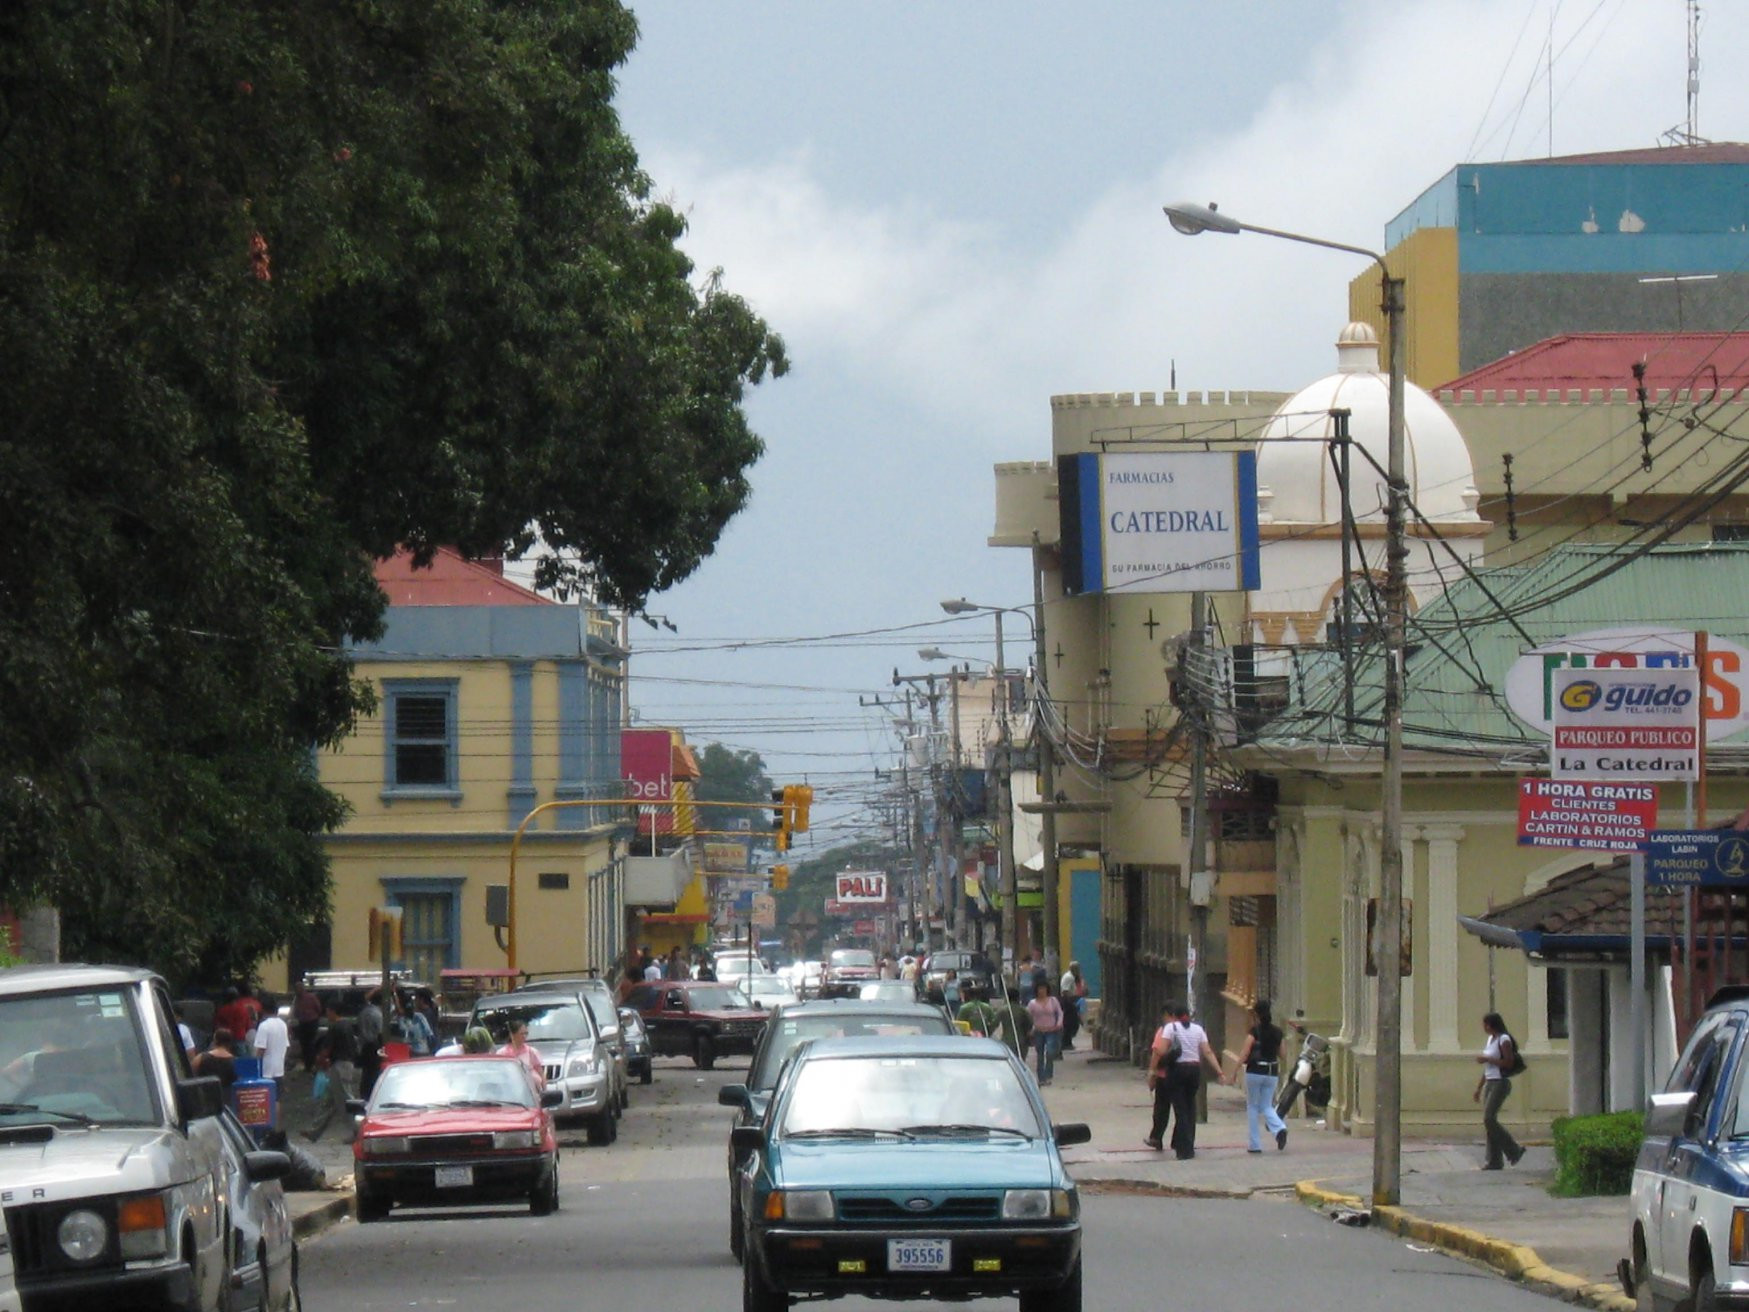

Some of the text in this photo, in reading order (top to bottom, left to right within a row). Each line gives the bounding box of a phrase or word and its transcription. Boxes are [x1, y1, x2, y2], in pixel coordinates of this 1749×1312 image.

[1109, 472, 1174, 484] FARMACIAS
[1111, 511, 1229, 533] CATEDRAL
[1126, 563, 1172, 573] FARMACIA
[1604, 684, 1692, 711] guido
[1560, 731, 1692, 746] PARQUEO PUBLICO
[1560, 757, 1693, 771] La Catedral
[1524, 783, 1653, 800] 1 HORA GRATIS
[1551, 799, 1616, 811] CLIENTES
[1531, 810, 1641, 825] LABORATORIOS
[1525, 822, 1646, 839] CARTIN & RAMOS
[1533, 836, 1638, 850] FRENTE CRUZ ROJA
[1650, 834, 1719, 843] LABORATORIOS
[1671, 845, 1698, 854] LABIN
[1654, 859, 1709, 870] PARQUEO
[1668, 871, 1701, 882] HORA
[895, 1248, 944, 1264] 395556
